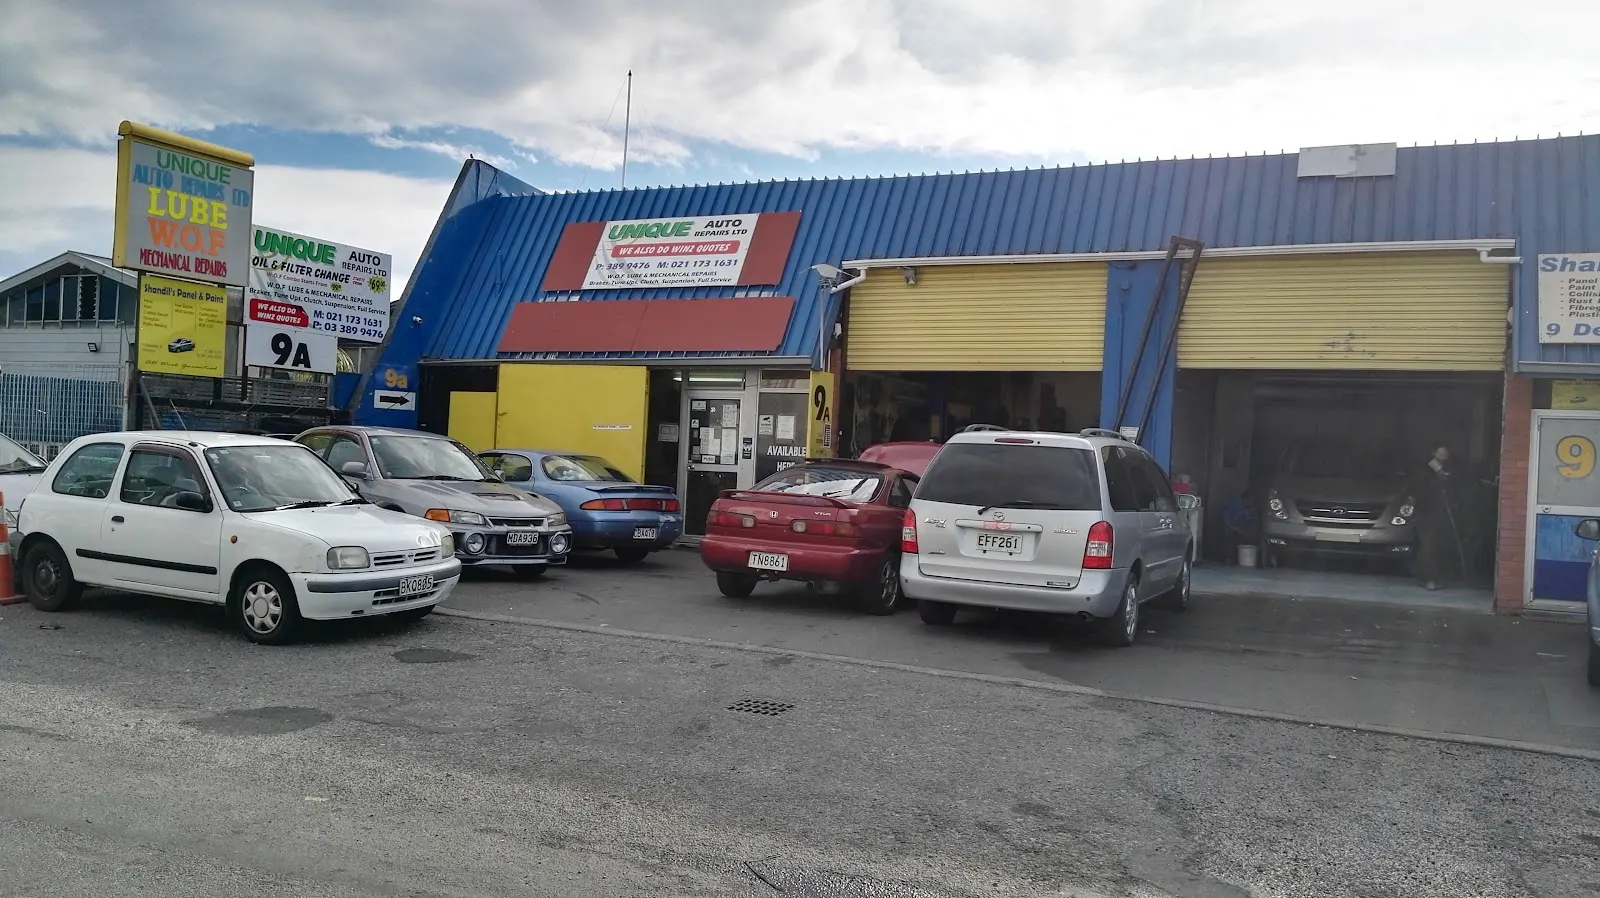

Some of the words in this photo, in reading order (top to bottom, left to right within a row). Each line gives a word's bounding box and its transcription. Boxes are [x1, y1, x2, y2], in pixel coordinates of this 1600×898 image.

[156, 150, 231, 185] UNIQUE
[133, 164, 174, 190] AUTO
[148, 186, 228, 230] LUBE
[608, 220, 694, 240] UNIQUE
[704, 218, 742, 228] AUTO
[694, 229, 730, 237] REPAIRS
[254, 229, 336, 266] UNIQUE
[348, 250, 381, 266] AUTO
[619, 247, 632, 256] WE
[634, 246, 656, 254] ALSO
[658, 246, 670, 254] DO
[672, 244, 694, 253] WINZ
[696, 243, 731, 252] QUOTES
[140, 248, 192, 272] MECHANICAL
[194, 258, 227, 278] REPAIRS
[252, 256, 268, 268] OIL
[271, 260, 278, 270] &
[280, 262, 312, 277] FILTER
[314, 268, 351, 284] CHANGE
[342, 262, 372, 276] REPAIRS
[374, 266, 387, 277] LTD
[1540, 256, 1600, 272] Sha
[144, 284, 176, 296] Shandil's
[177, 289, 197, 300] Panel
[198, 292, 204, 300] &
[206, 293, 224, 304] Paint
[249, 287, 272, 298] Brakes,
[274, 291, 289, 299] Tune
[303, 296, 323, 306] Clutch,
[325, 300, 356, 311] Suspension,
[368, 307, 386, 316] Service
[288, 285, 304, 294] LUBE
[310, 289, 349, 301] MECHANICAL
[350, 296, 373, 305] REPAIRS
[258, 302, 270, 310] WE
[269, 304, 286, 313] ALSO
[257, 311, 275, 320] WINZ
[276, 314, 301, 324] QUOTES
[313, 310, 324, 319] M:
[326, 312, 342, 322] 021
[345, 314, 361, 325] 173
[363, 317, 382, 328] 1631
[312, 320, 322, 330] P:
[324, 322, 337, 332] 03
[339, 325, 358, 335] 389
[360, 328, 384, 338] 9476
[1546, 323, 1560, 336] 9
[271, 332, 312, 368] 9A
[767, 446, 806, 456] AVAILABLE
[1556, 435, 1597, 480] 9
[507, 534, 538, 543] MDA936
[978, 535, 1018, 549] EFF261
[752, 552, 785, 568] TN8861
